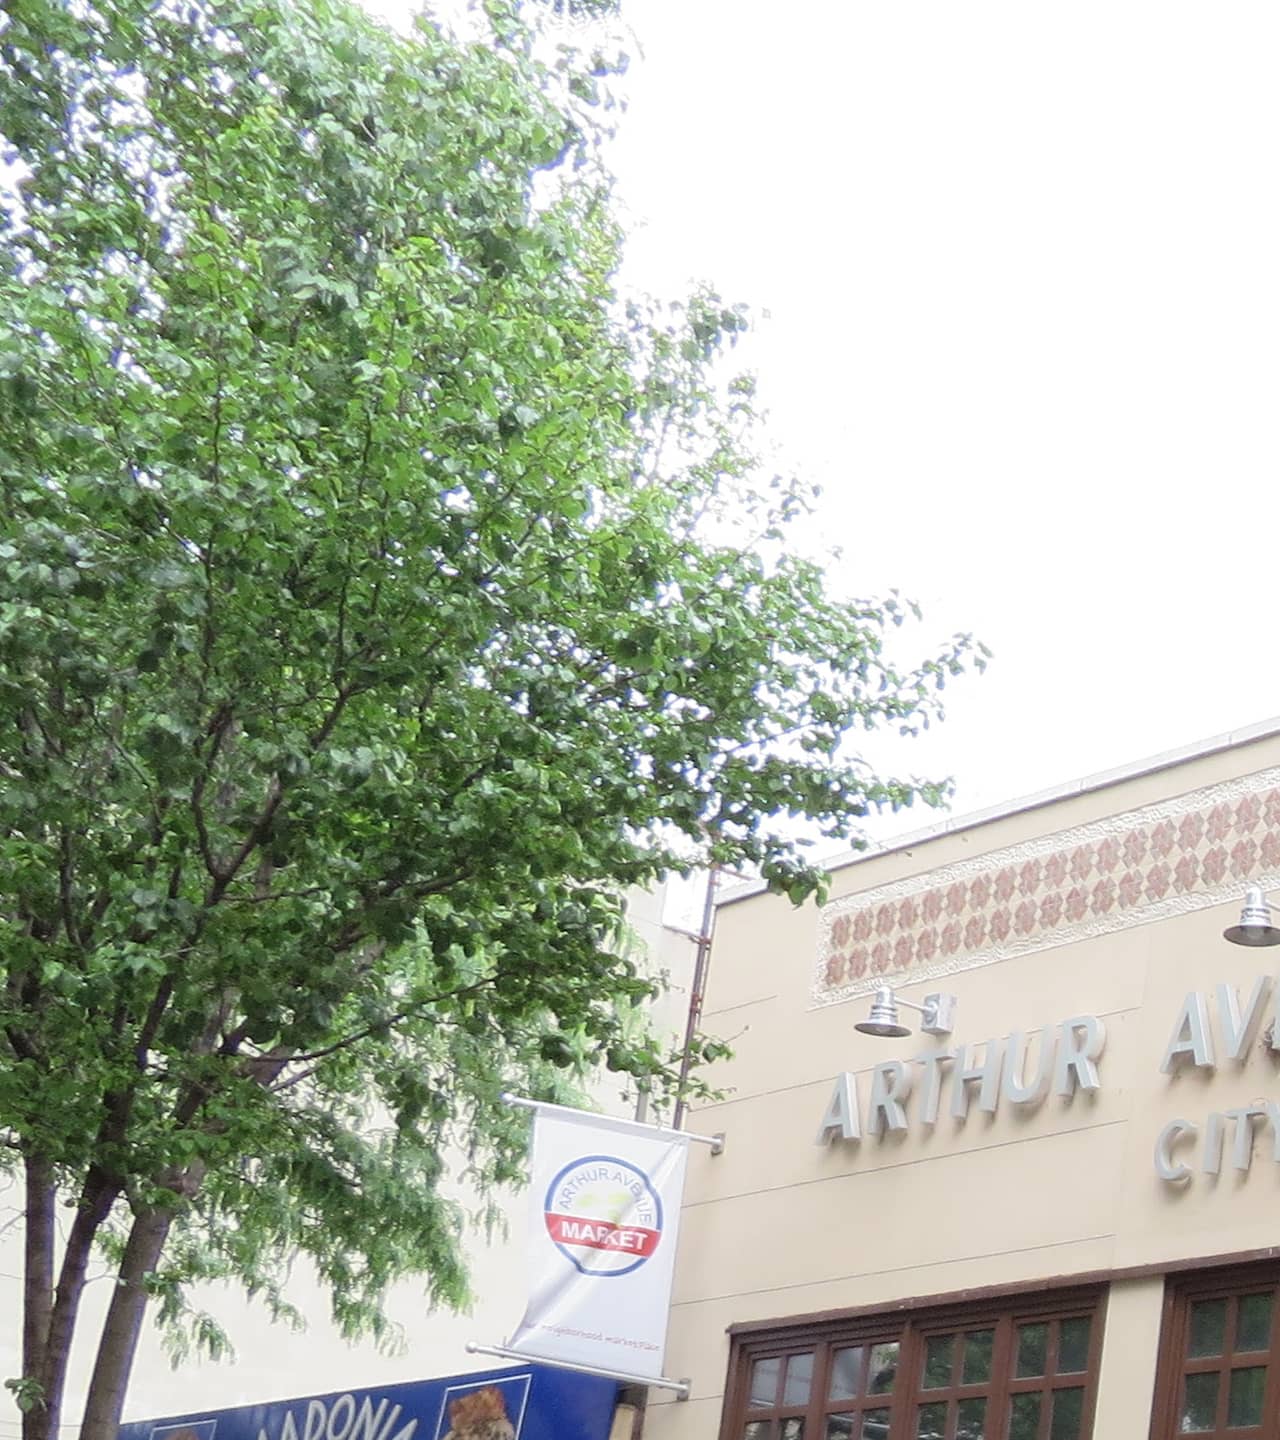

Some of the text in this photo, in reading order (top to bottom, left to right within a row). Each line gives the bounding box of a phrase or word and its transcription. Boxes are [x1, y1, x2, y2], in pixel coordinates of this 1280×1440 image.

[815, 1015, 1106, 1146] ARTHUR
[558, 1167, 609, 1210] ARTHUR
[561, 1220, 648, 1250] MARKET
